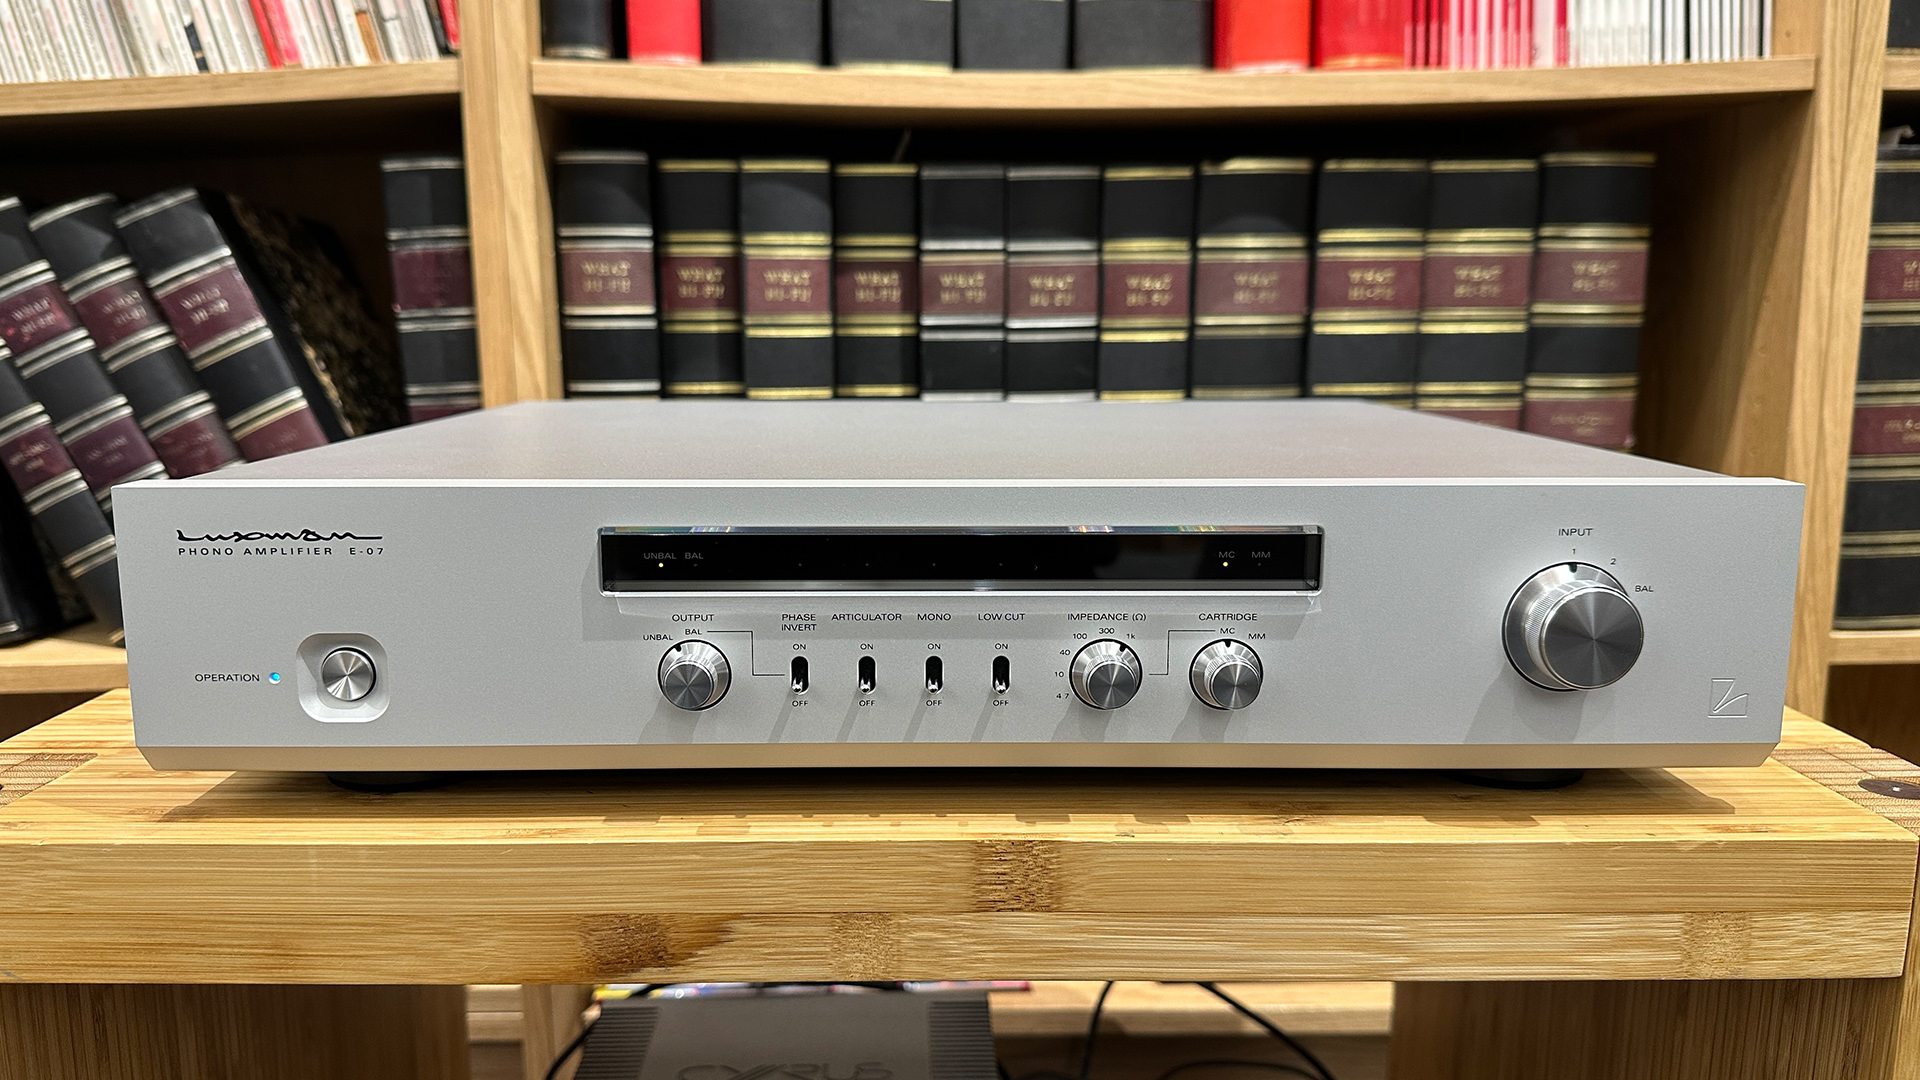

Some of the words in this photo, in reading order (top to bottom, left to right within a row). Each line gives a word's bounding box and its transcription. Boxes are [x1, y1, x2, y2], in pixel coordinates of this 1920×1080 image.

[1558, 527, 1594, 537] INPUT
[178, 547, 234, 556] PHONO
[243, 547, 332, 556] AMPLIFIER
[349, 547, 384, 556] E-07
[643, 552, 677, 560] UNBAL
[684, 552, 704, 560] BAL
[1218, 550, 1236, 559] MC
[1251, 551, 1271, 559] MM
[1610, 557, 1617, 566] 2
[1634, 584, 1654, 593] BAL
[671, 613, 715, 622] OUTPUT
[781, 613, 816, 622] PHASE
[831, 613, 902, 622] ARTICULATOR
[917, 613, 952, 622] MONO
[977, 613, 1004, 622] LOW
[1004, 613, 1026, 622] CUT
[1067, 612, 1129, 621] IMPEDANCE
[1131, 613, 1147, 622] (Ω)
[1198, 612, 1258, 622] CARTRIDGE
[684, 628, 702, 636] BAL
[781, 623, 817, 632] INVERT
[1098, 627, 1115, 635] 300
[1220, 627, 1236, 635] MC
[642, 633, 674, 641] UNBAL
[1072, 632, 1088, 640] 100
[792, 643, 807, 651] ON
[859, 643, 874, 651] ON
[927, 642, 941, 650] ON
[994, 642, 1009, 650] ON
[194, 673, 260, 682] OPERATION
[1054, 670, 1065, 678] 10
[791, 699, 809, 708] OFF
[858, 699, 875, 707] OFF
[925, 699, 942, 707] OFF
[992, 699, 1009, 707] OFF
